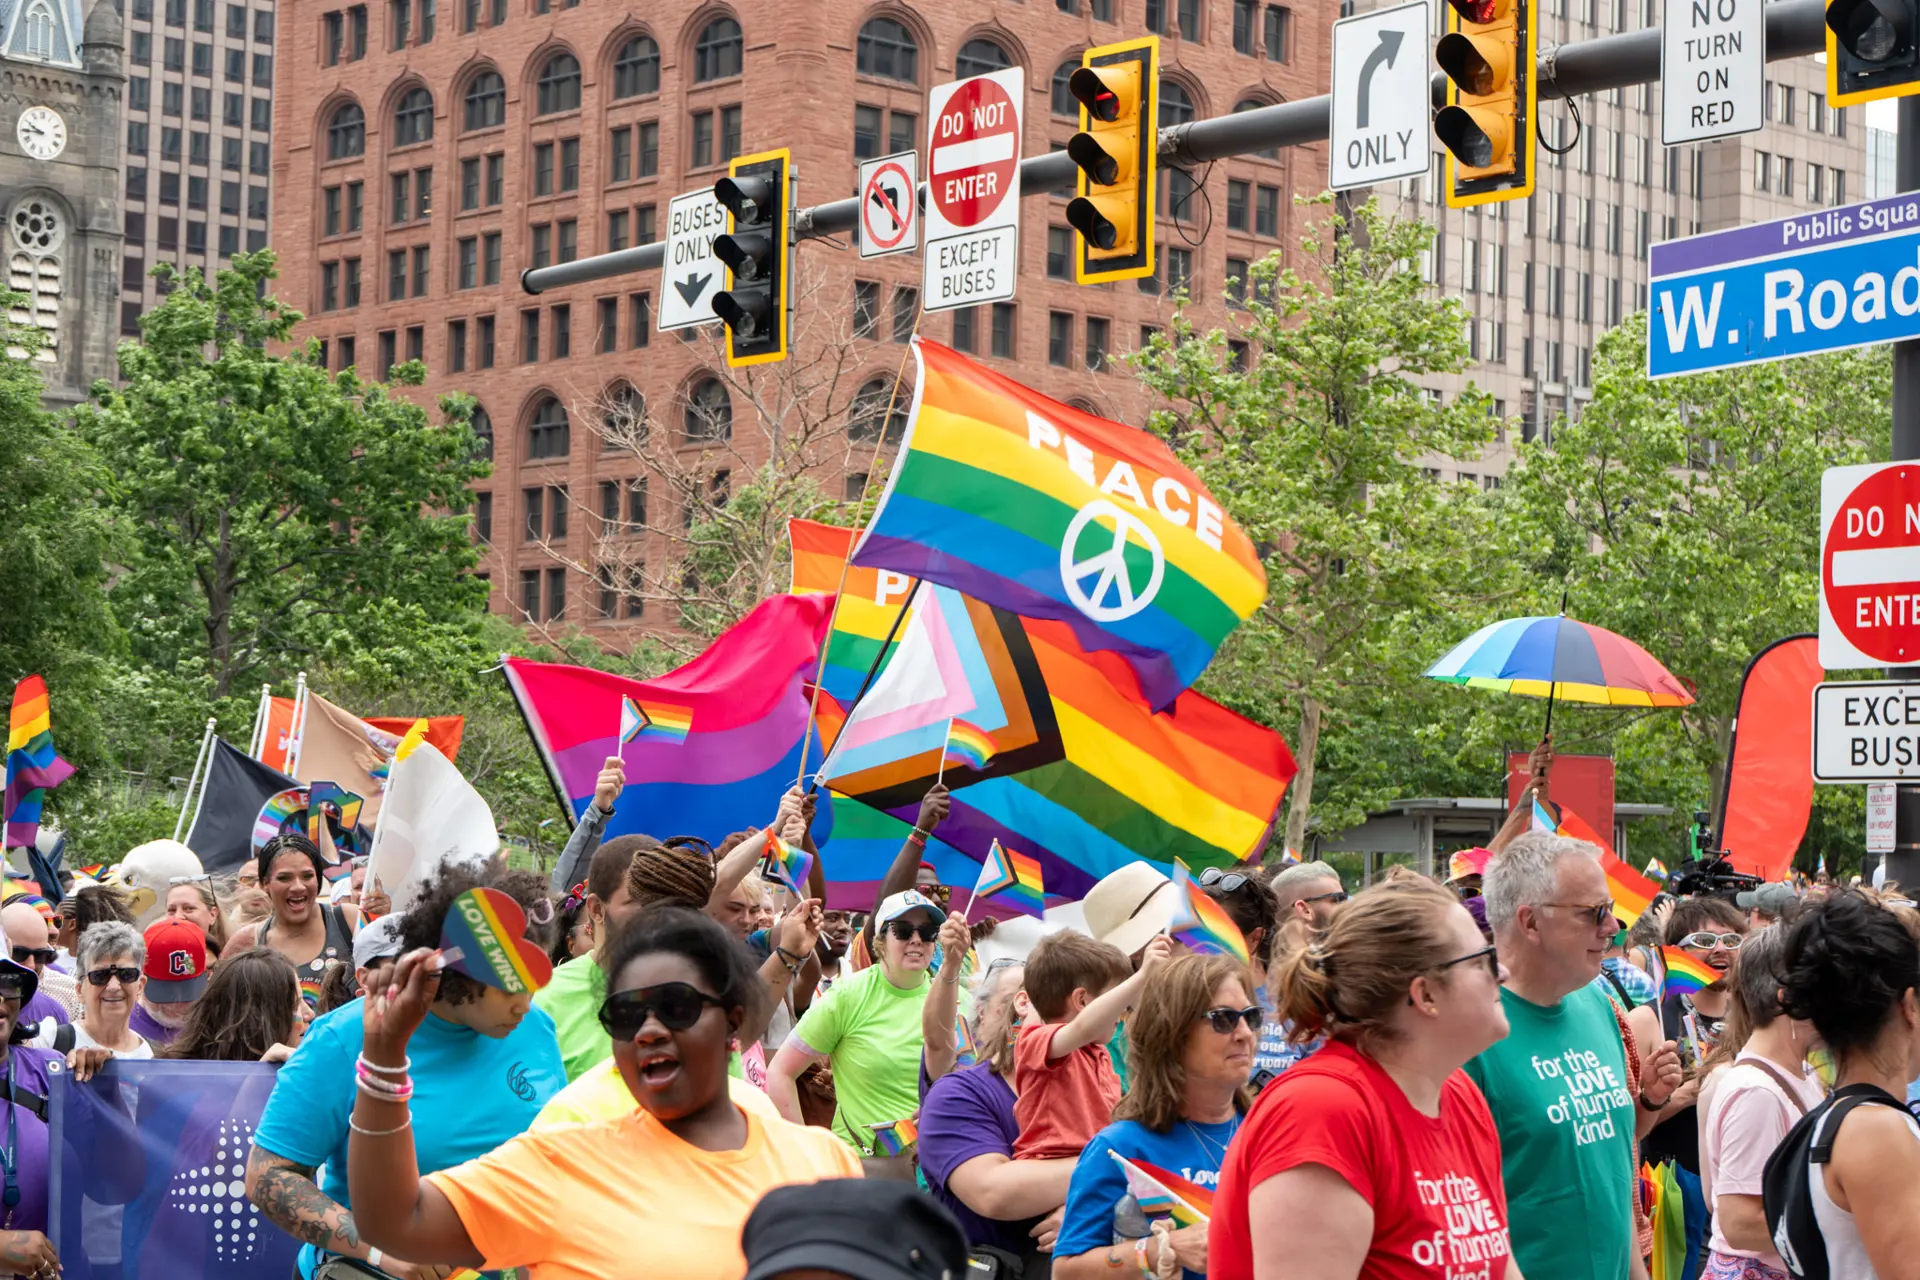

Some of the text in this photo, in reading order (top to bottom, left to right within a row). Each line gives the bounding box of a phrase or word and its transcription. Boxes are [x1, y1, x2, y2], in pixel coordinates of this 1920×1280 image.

[1692, 0, 1736, 28] NO
[1684, 30, 1742, 62] TURN
[1697, 66, 1728, 93] ON
[942, 101, 1008, 138] DO NOT
[1691, 100, 1734, 128] RED
[1347, 128, 1413, 170] ONLY
[945, 172, 997, 204] ENTER
[673, 201, 723, 236] BUSES
[1783, 202, 1919, 245] Public Squa
[675, 232, 717, 265] ONLY
[940, 236, 1001, 268] EXCEPT
[942, 268, 996, 298] BUSES
[1659, 244, 1920, 354] W. Road
[1025, 408, 1224, 553] PEACE
[1846, 505, 1884, 539] DO
[1856, 594, 1920, 628] ENTE
[1845, 695, 1920, 726] EXCE
[1851, 736, 1920, 766] BUS
[458, 898, 523, 993] LOVE WINS
[1531, 1047, 1600, 1080] for the
[1564, 1065, 1619, 1097] LOVE
[1547, 1087, 1631, 1124] of human
[1573, 1111, 1615, 1146] kind
[1444, 1170, 1480, 1204] the
[1444, 1198, 1499, 1236] LOVE
[1412, 1230, 1445, 1266] of
